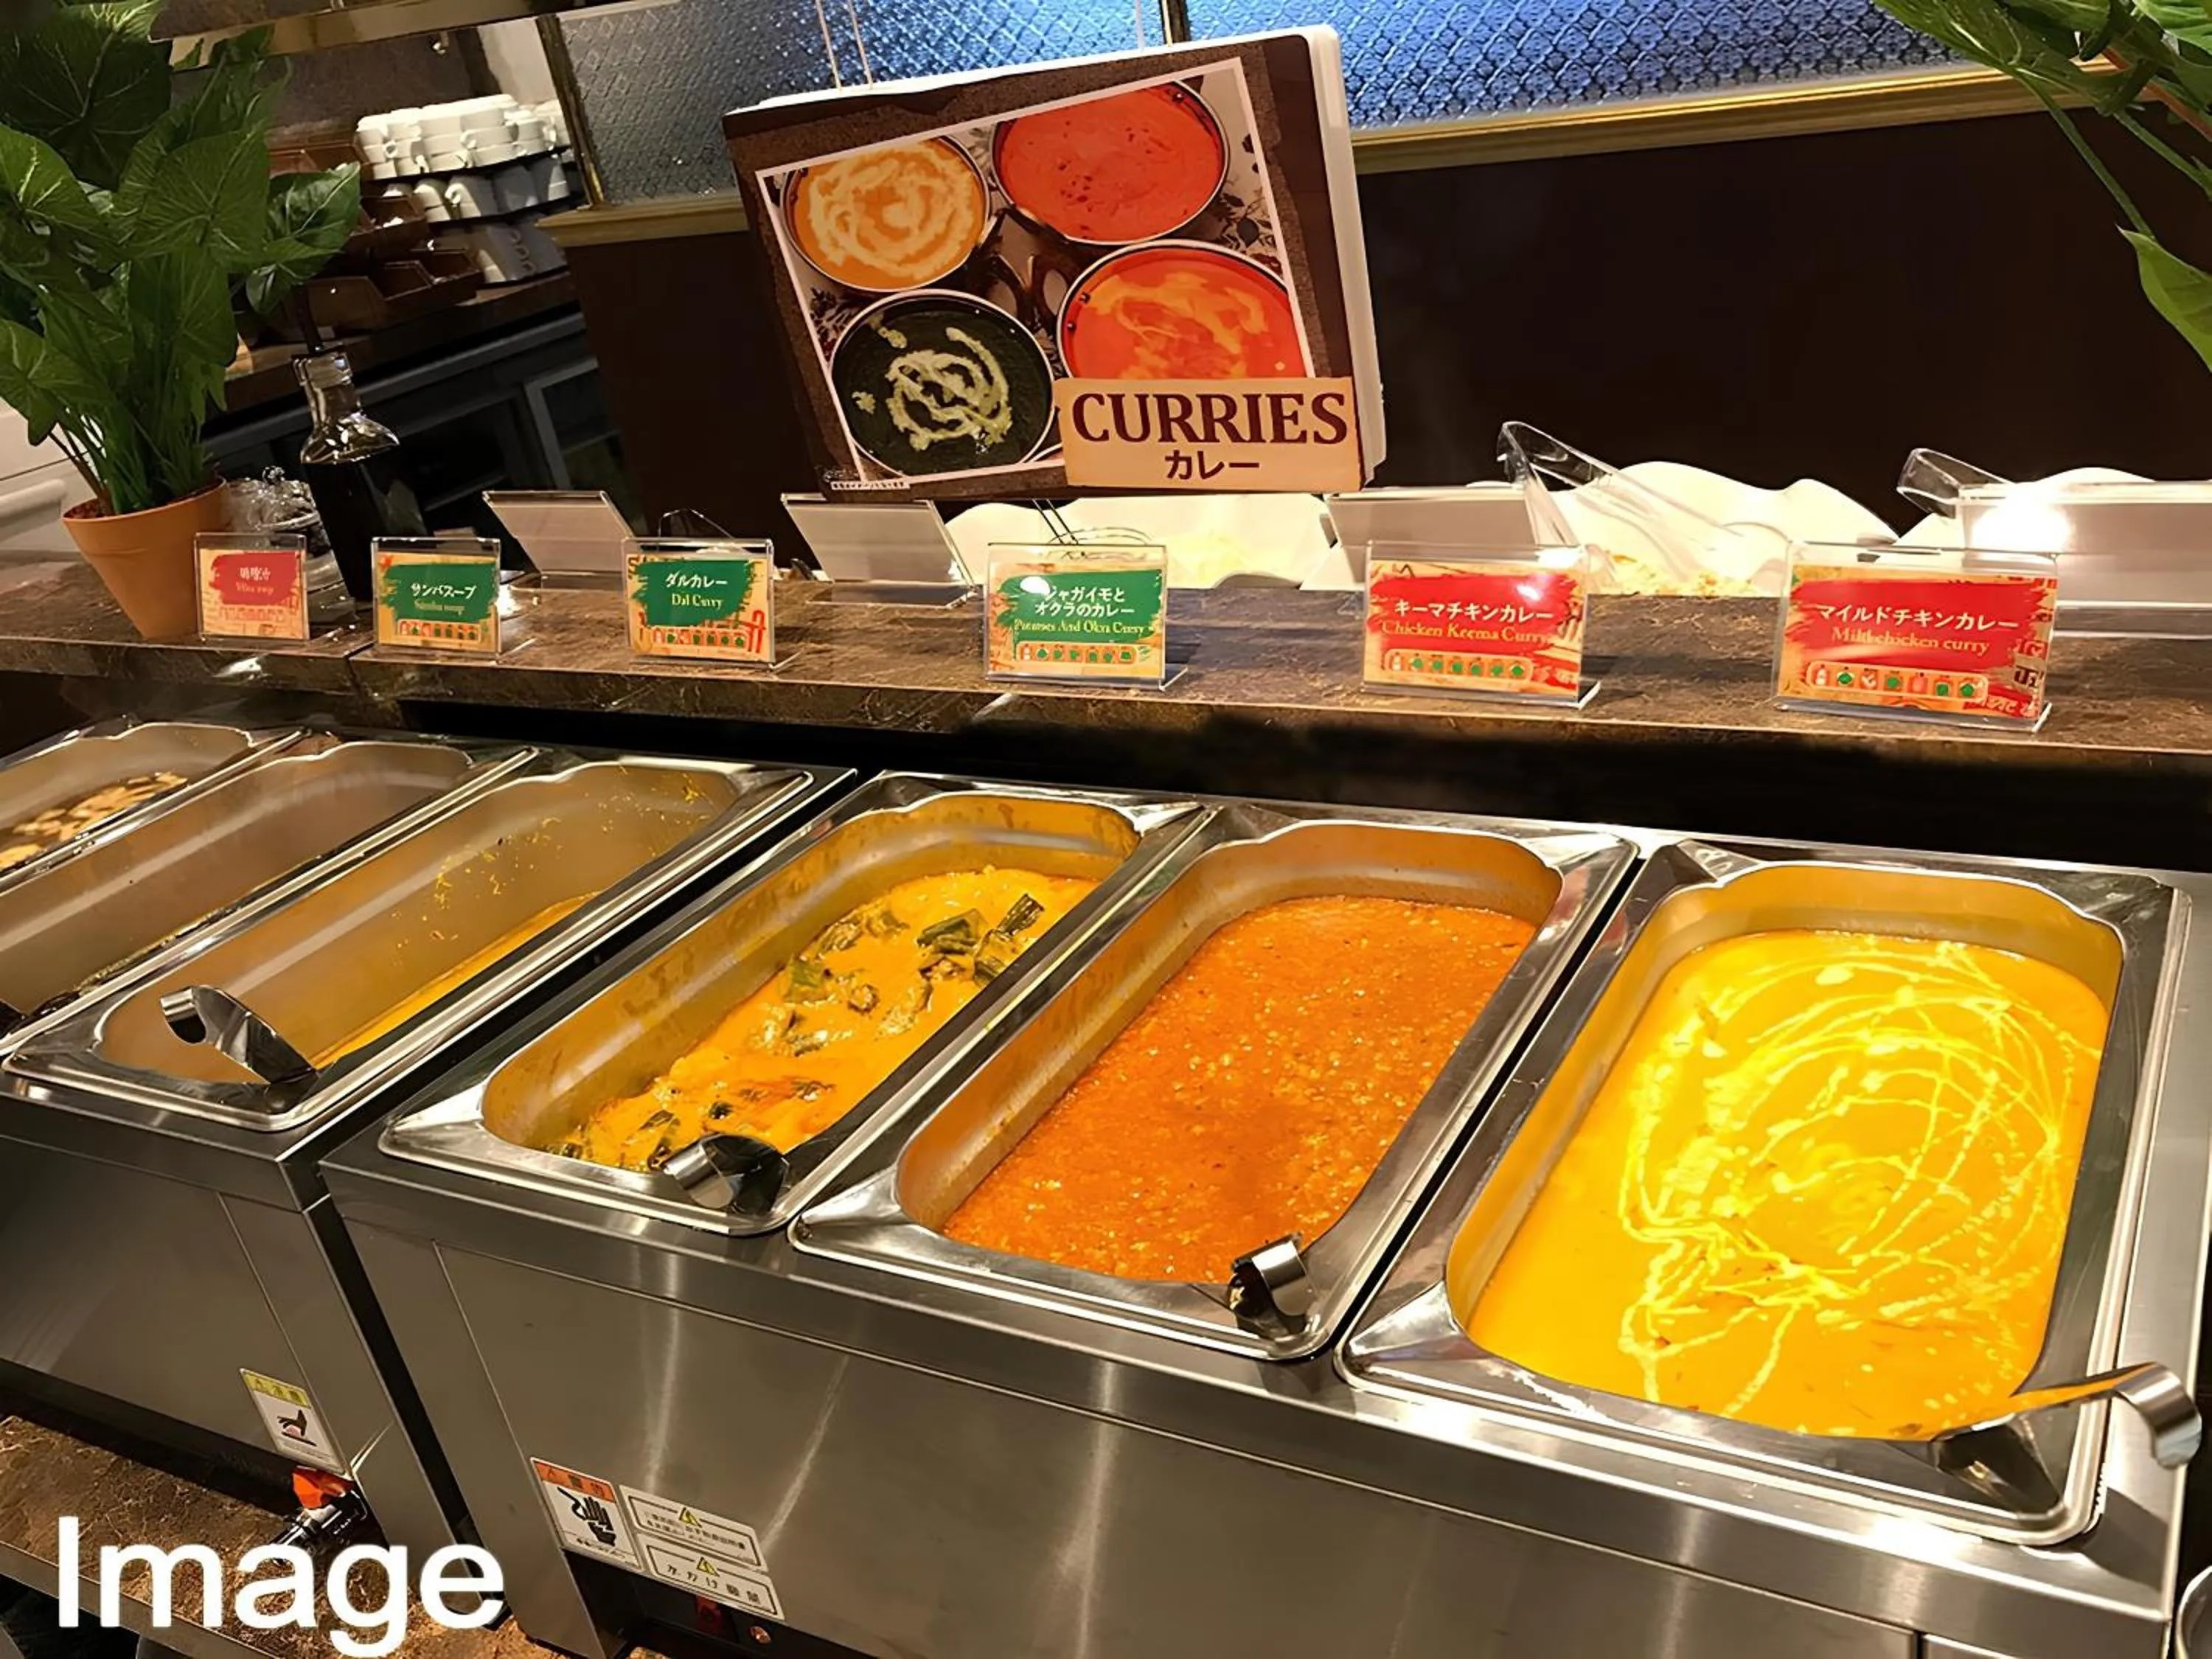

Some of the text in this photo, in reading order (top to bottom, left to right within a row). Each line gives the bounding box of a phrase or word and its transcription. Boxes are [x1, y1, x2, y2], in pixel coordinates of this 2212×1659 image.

[1071, 392, 1348, 445] CURRIES
[1164, 449, 1260, 480] カレー
[1034, 601, 1135, 618] オクラのカレー
[1394, 599, 1554, 624] キーマチキンカレー
[1815, 603, 2019, 631] マイルドチキンカレー
[1381, 620, 1549, 647] Chicken Keema Curry
[1943, 638, 1990, 656] curry
